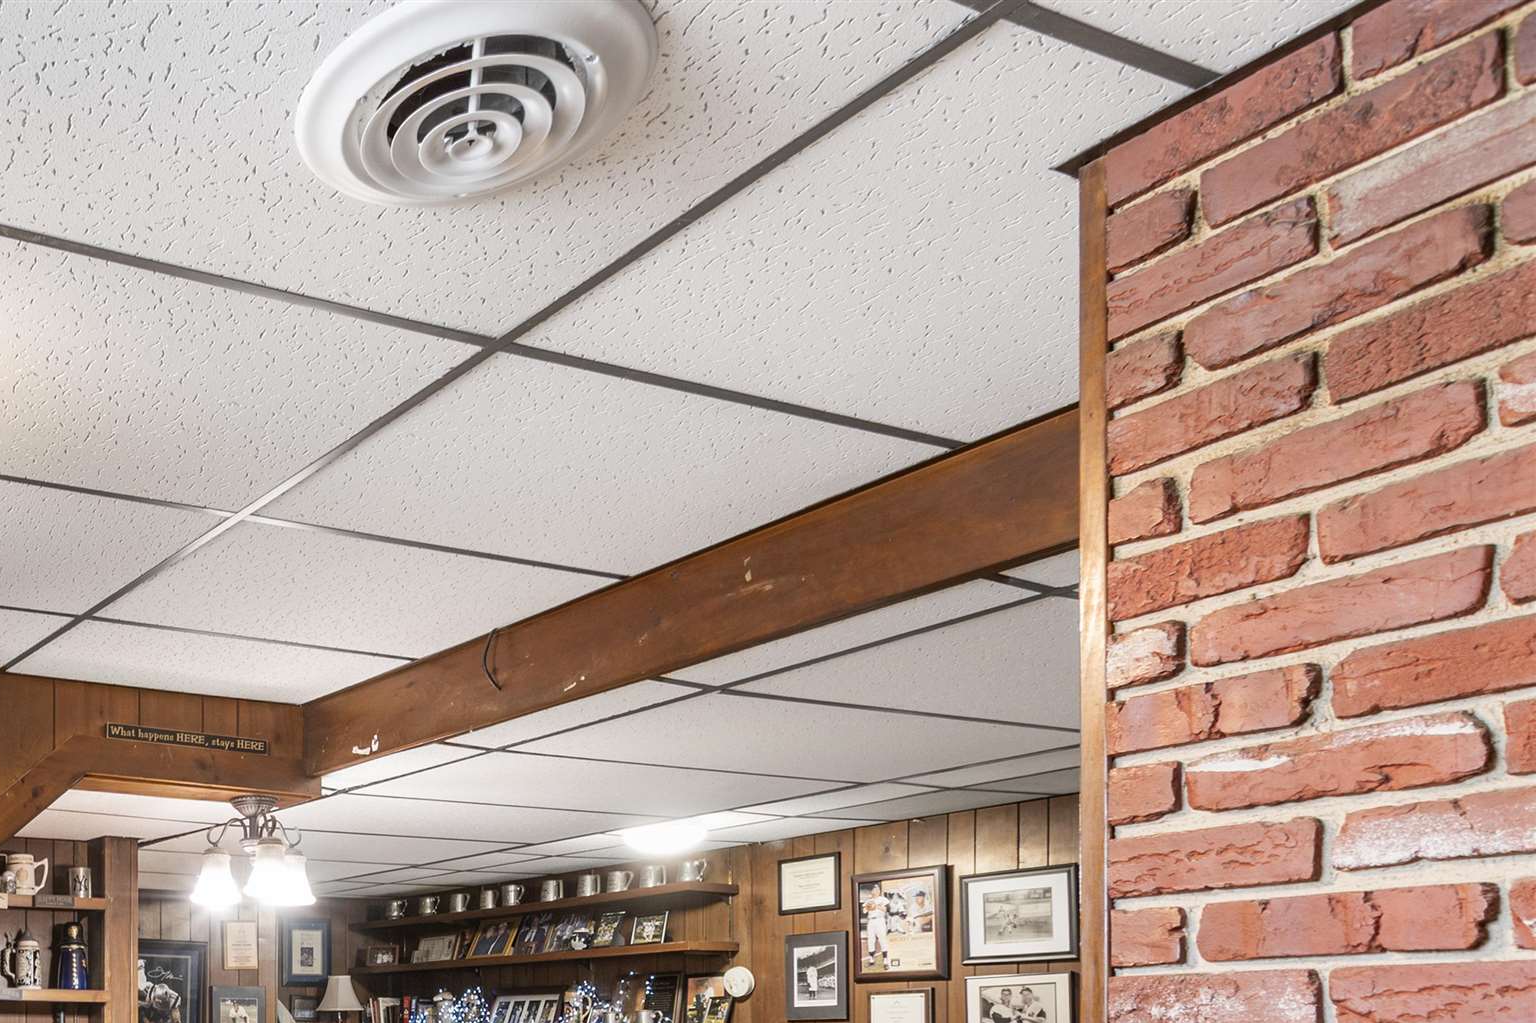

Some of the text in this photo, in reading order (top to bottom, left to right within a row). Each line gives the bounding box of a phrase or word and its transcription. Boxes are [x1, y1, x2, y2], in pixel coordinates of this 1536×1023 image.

[110, 725, 265, 751] What happens HERE, stays HERE
